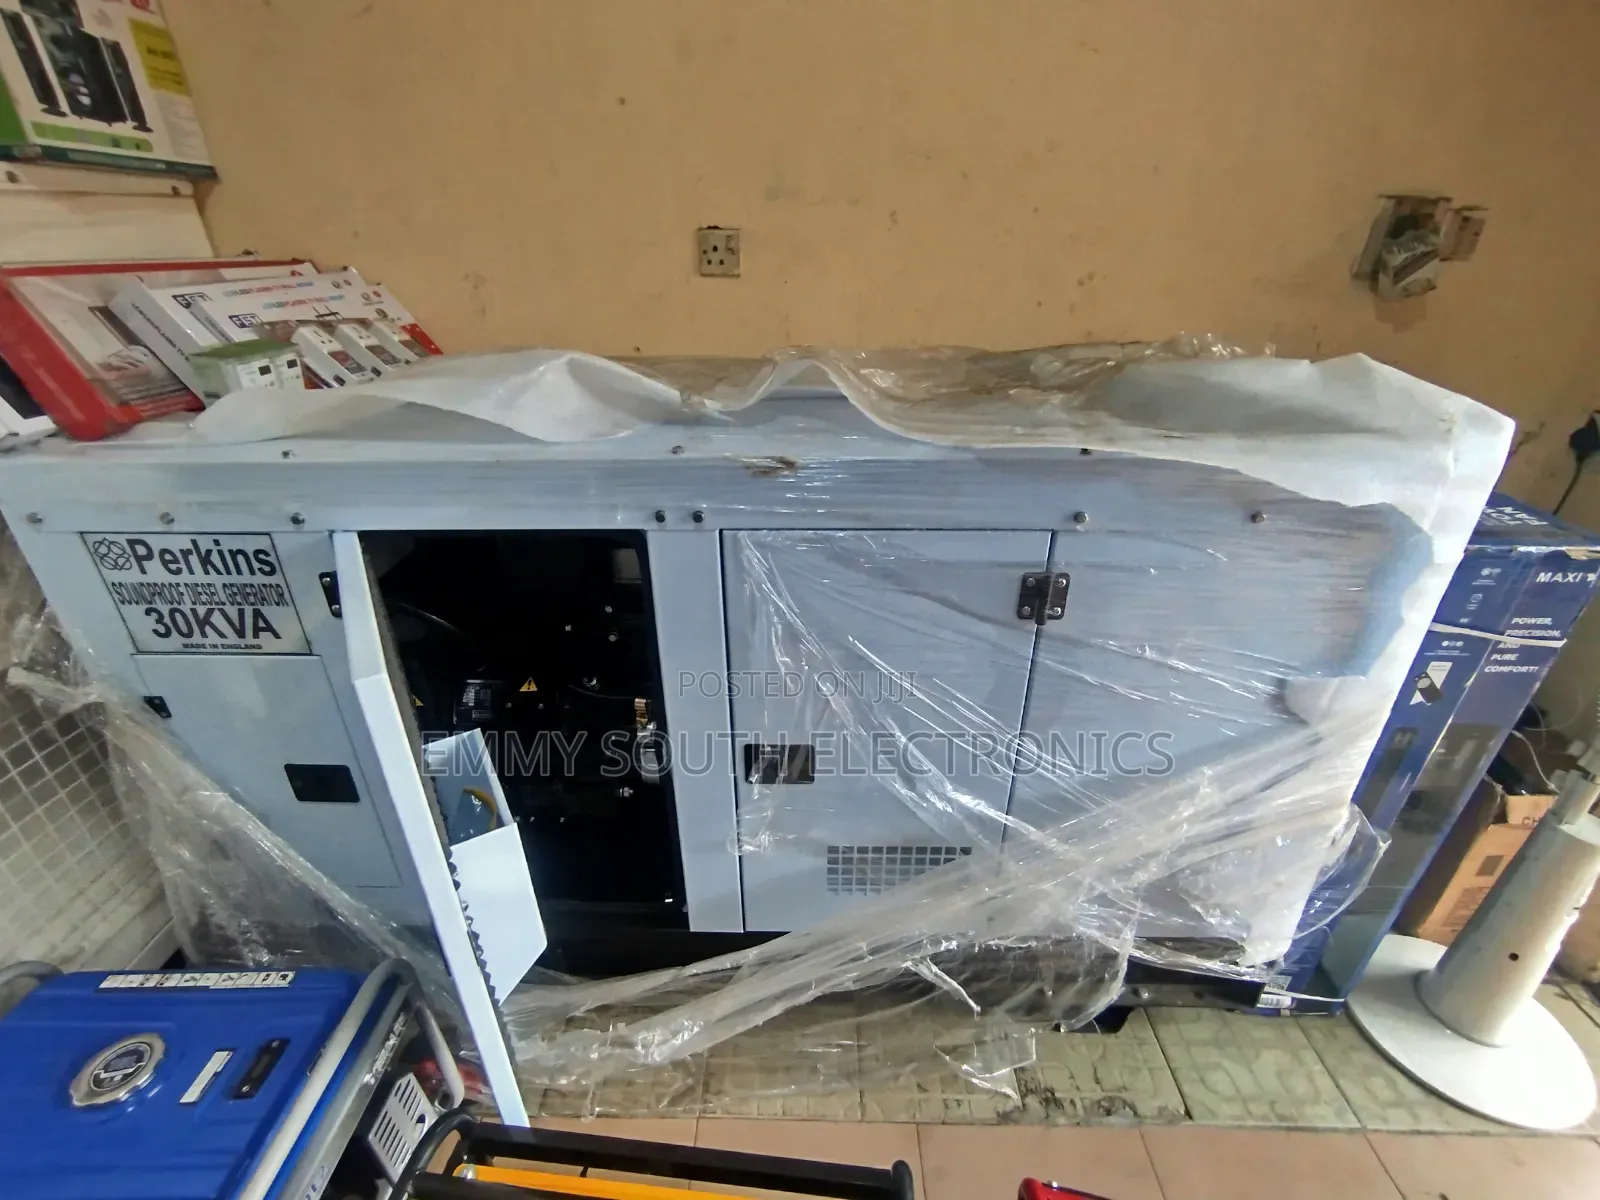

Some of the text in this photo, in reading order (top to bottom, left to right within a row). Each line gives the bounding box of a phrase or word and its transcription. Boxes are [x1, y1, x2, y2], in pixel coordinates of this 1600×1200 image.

[125, 538, 277, 577] Perkins
[1535, 572, 1584, 583] MAXI
[111, 582, 290, 607] SOUNDPROOF DIESEL GENERATOR
[144, 607, 282, 640] 30KVA
[1496, 641, 1521, 649] AND
[1490, 653, 1520, 661] PURE
[1484, 665, 1540, 673] COMFORT!
